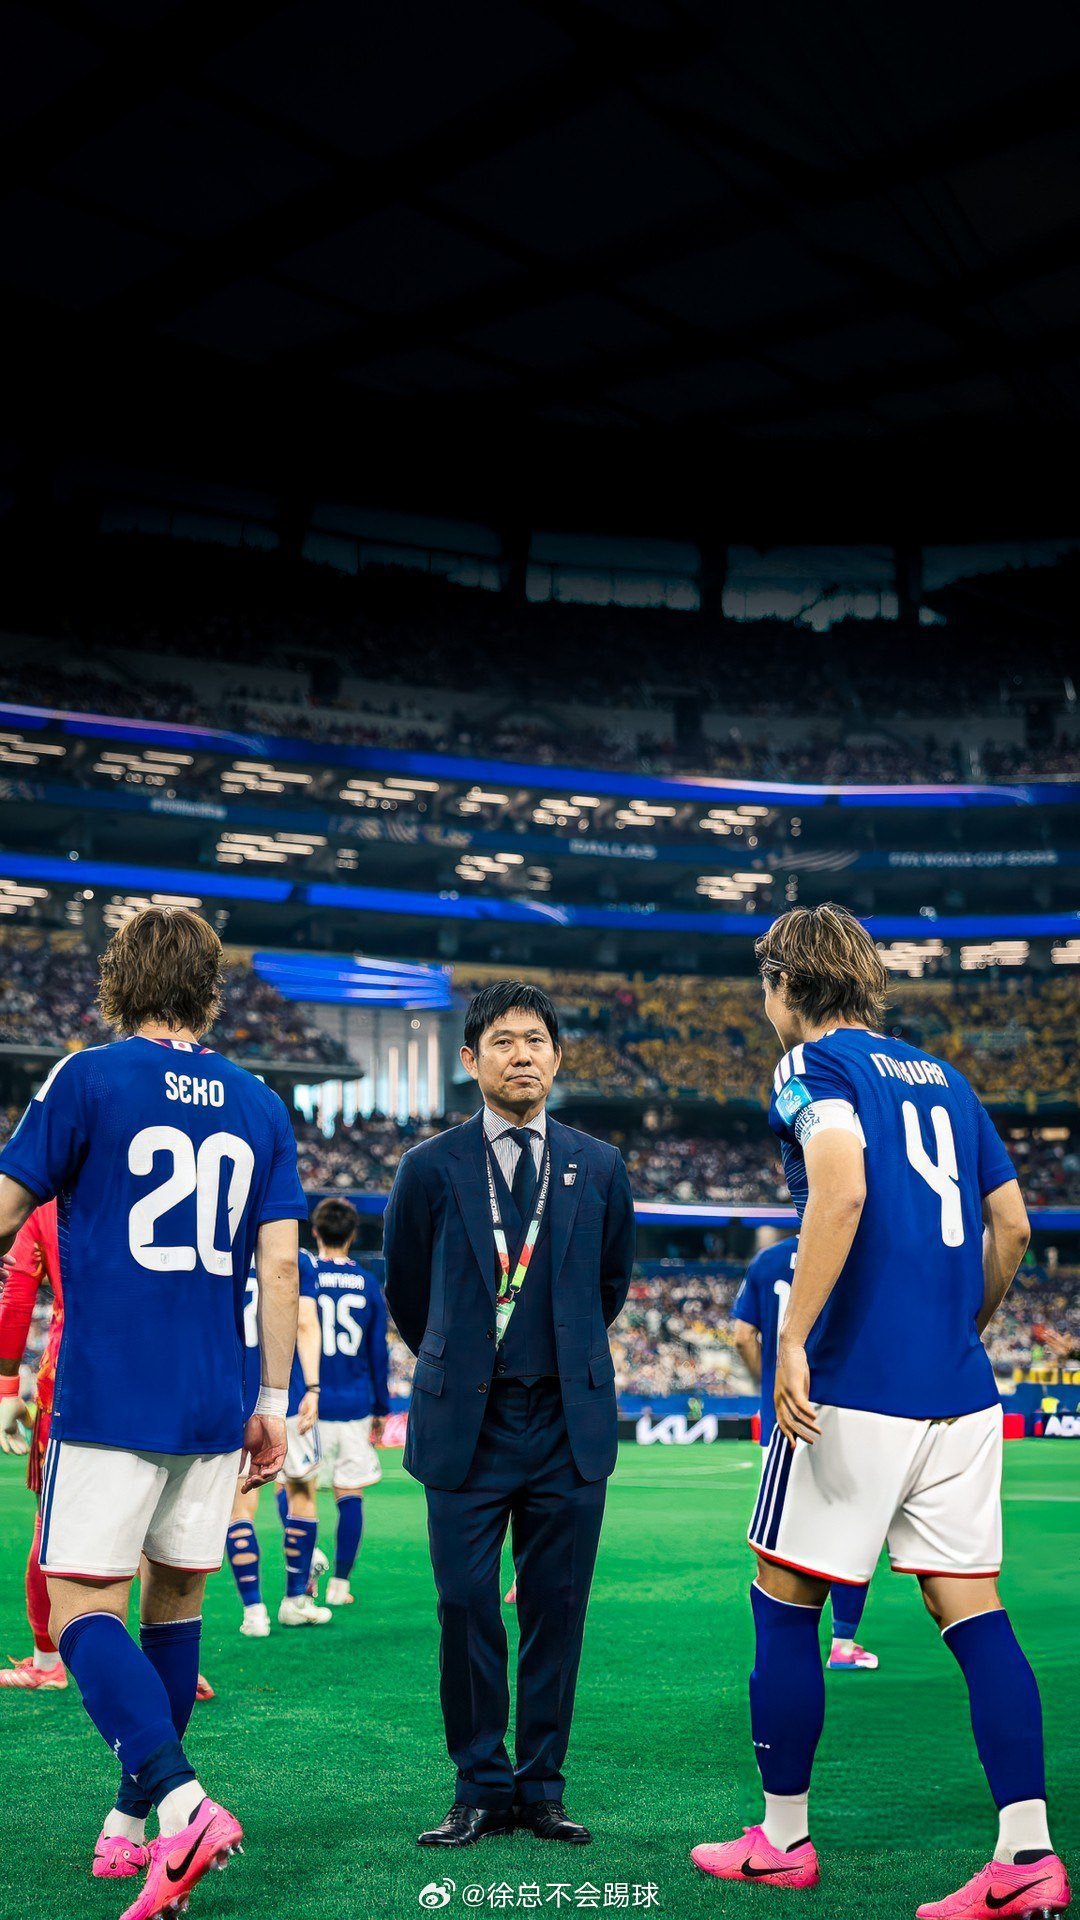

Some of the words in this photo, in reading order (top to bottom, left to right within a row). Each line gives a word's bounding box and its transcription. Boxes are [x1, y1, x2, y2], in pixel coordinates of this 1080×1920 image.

[164, 1071, 225, 1107] SEKO
[128, 1125, 255, 1276] 20
[902, 1100, 965, 1248] 4
[317, 1293, 367, 1357] 15
